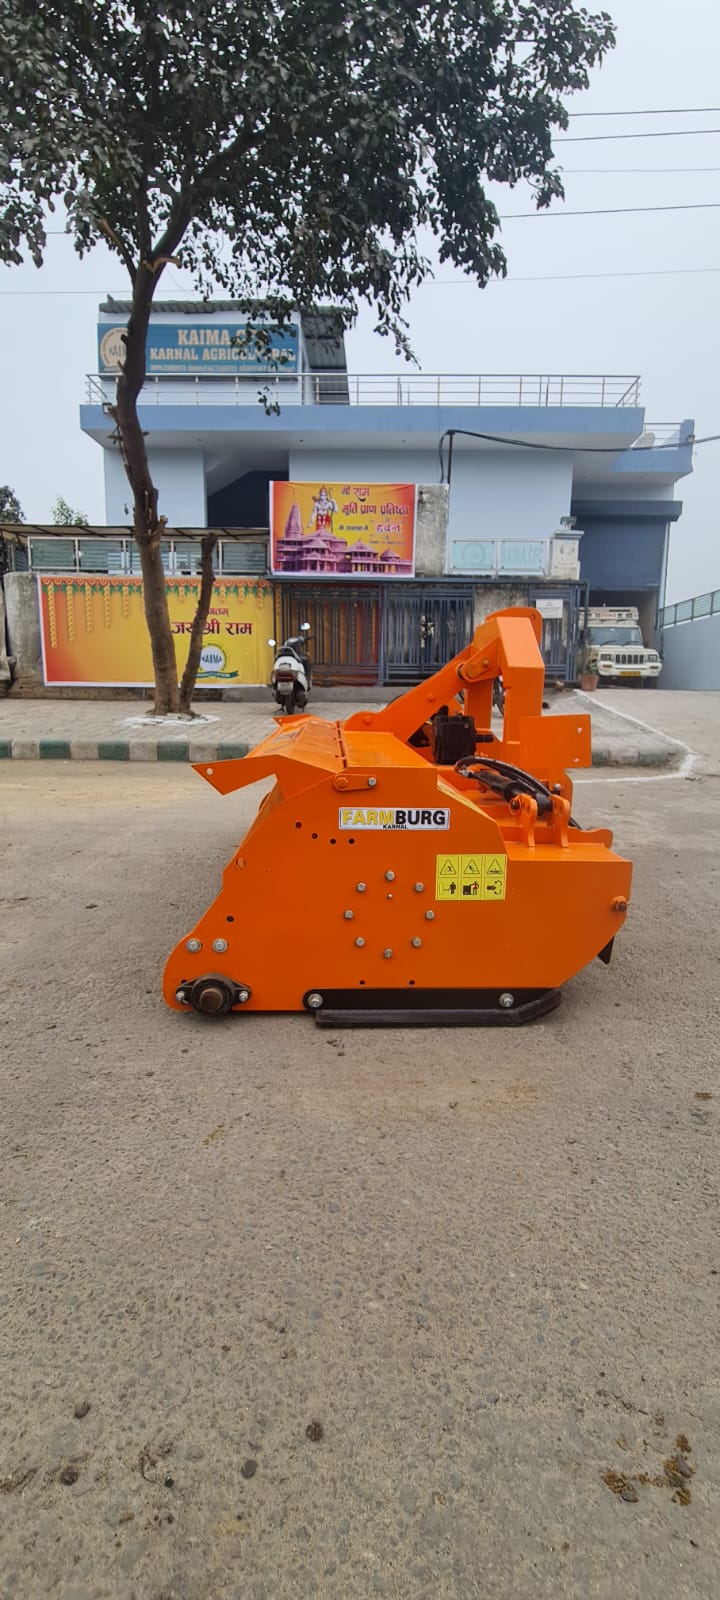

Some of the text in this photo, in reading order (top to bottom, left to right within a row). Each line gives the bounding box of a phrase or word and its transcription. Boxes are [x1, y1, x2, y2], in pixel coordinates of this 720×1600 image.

[177, 329, 232, 346] KAIMA
[150, 347, 199, 360] KARNAL
[361, 504, 377, 515] प्राण
[376, 523, 400, 533] हवन
[225, 622, 253, 635] राम
[342, 810, 445, 824] FARMBURG
